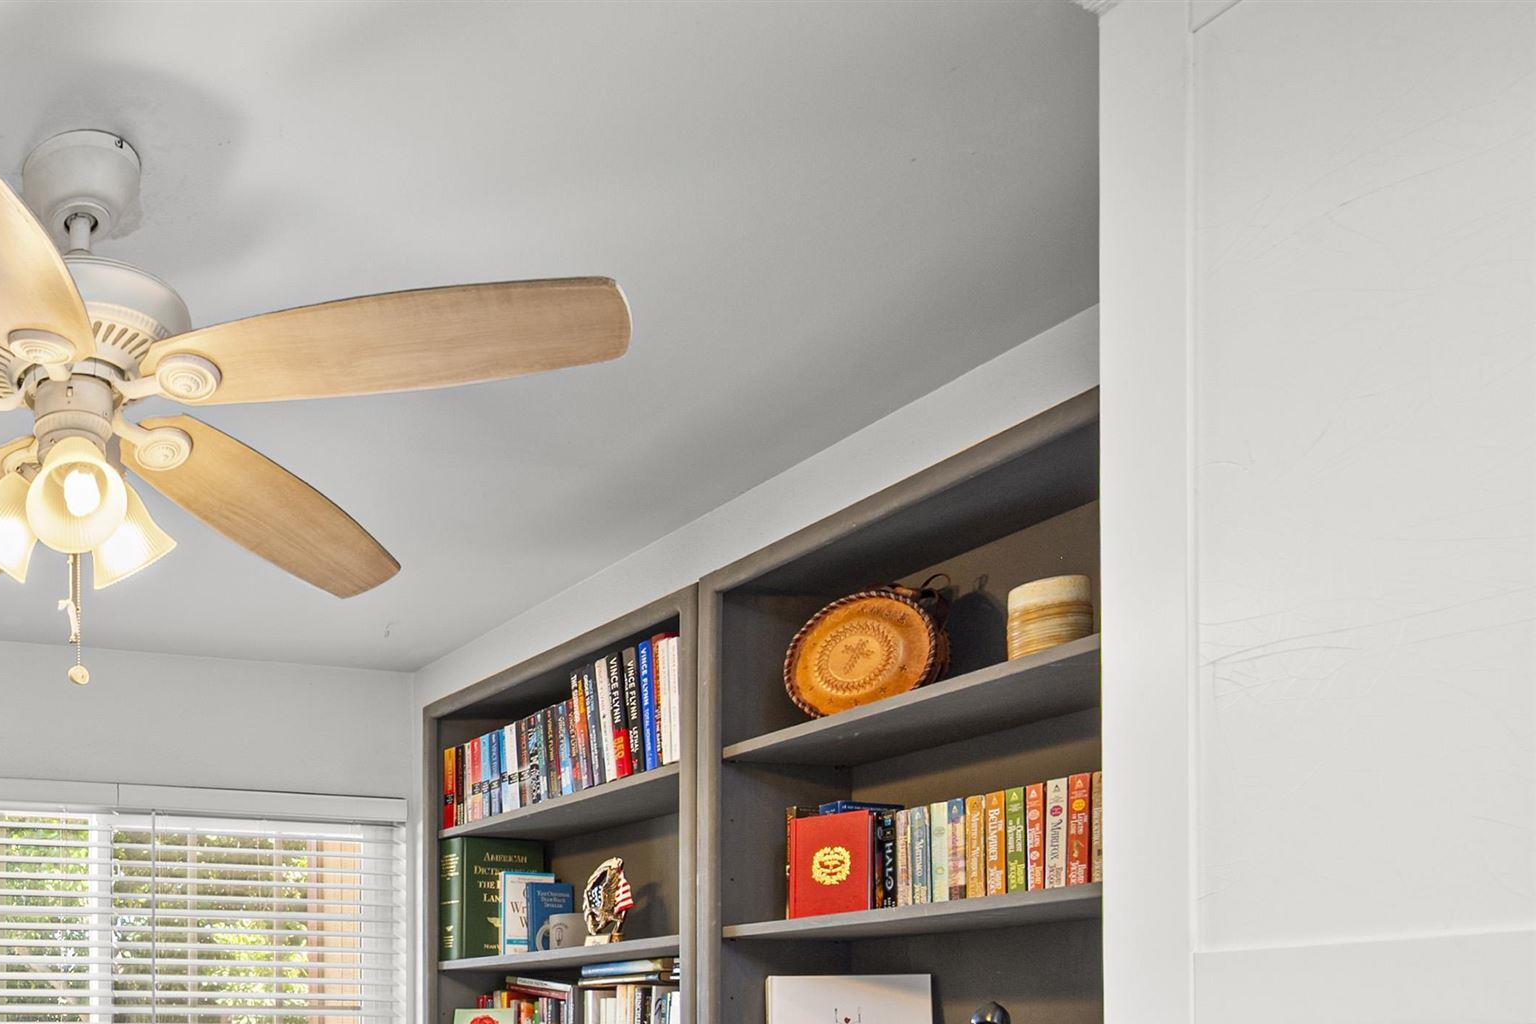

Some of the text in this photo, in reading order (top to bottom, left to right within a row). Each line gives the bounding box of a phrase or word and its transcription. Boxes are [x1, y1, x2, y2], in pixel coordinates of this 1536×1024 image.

[608, 658, 618, 690] VINCE
[627, 660, 635, 688] VINCE
[639, 648, 647, 676] VINCE
[629, 691, 638, 720] FLYNN
[642, 678, 650, 706] FLYNN
[611, 691, 621, 723] FLYNN
[885, 842, 894, 890] HALO
[477, 880, 495, 889] THE
